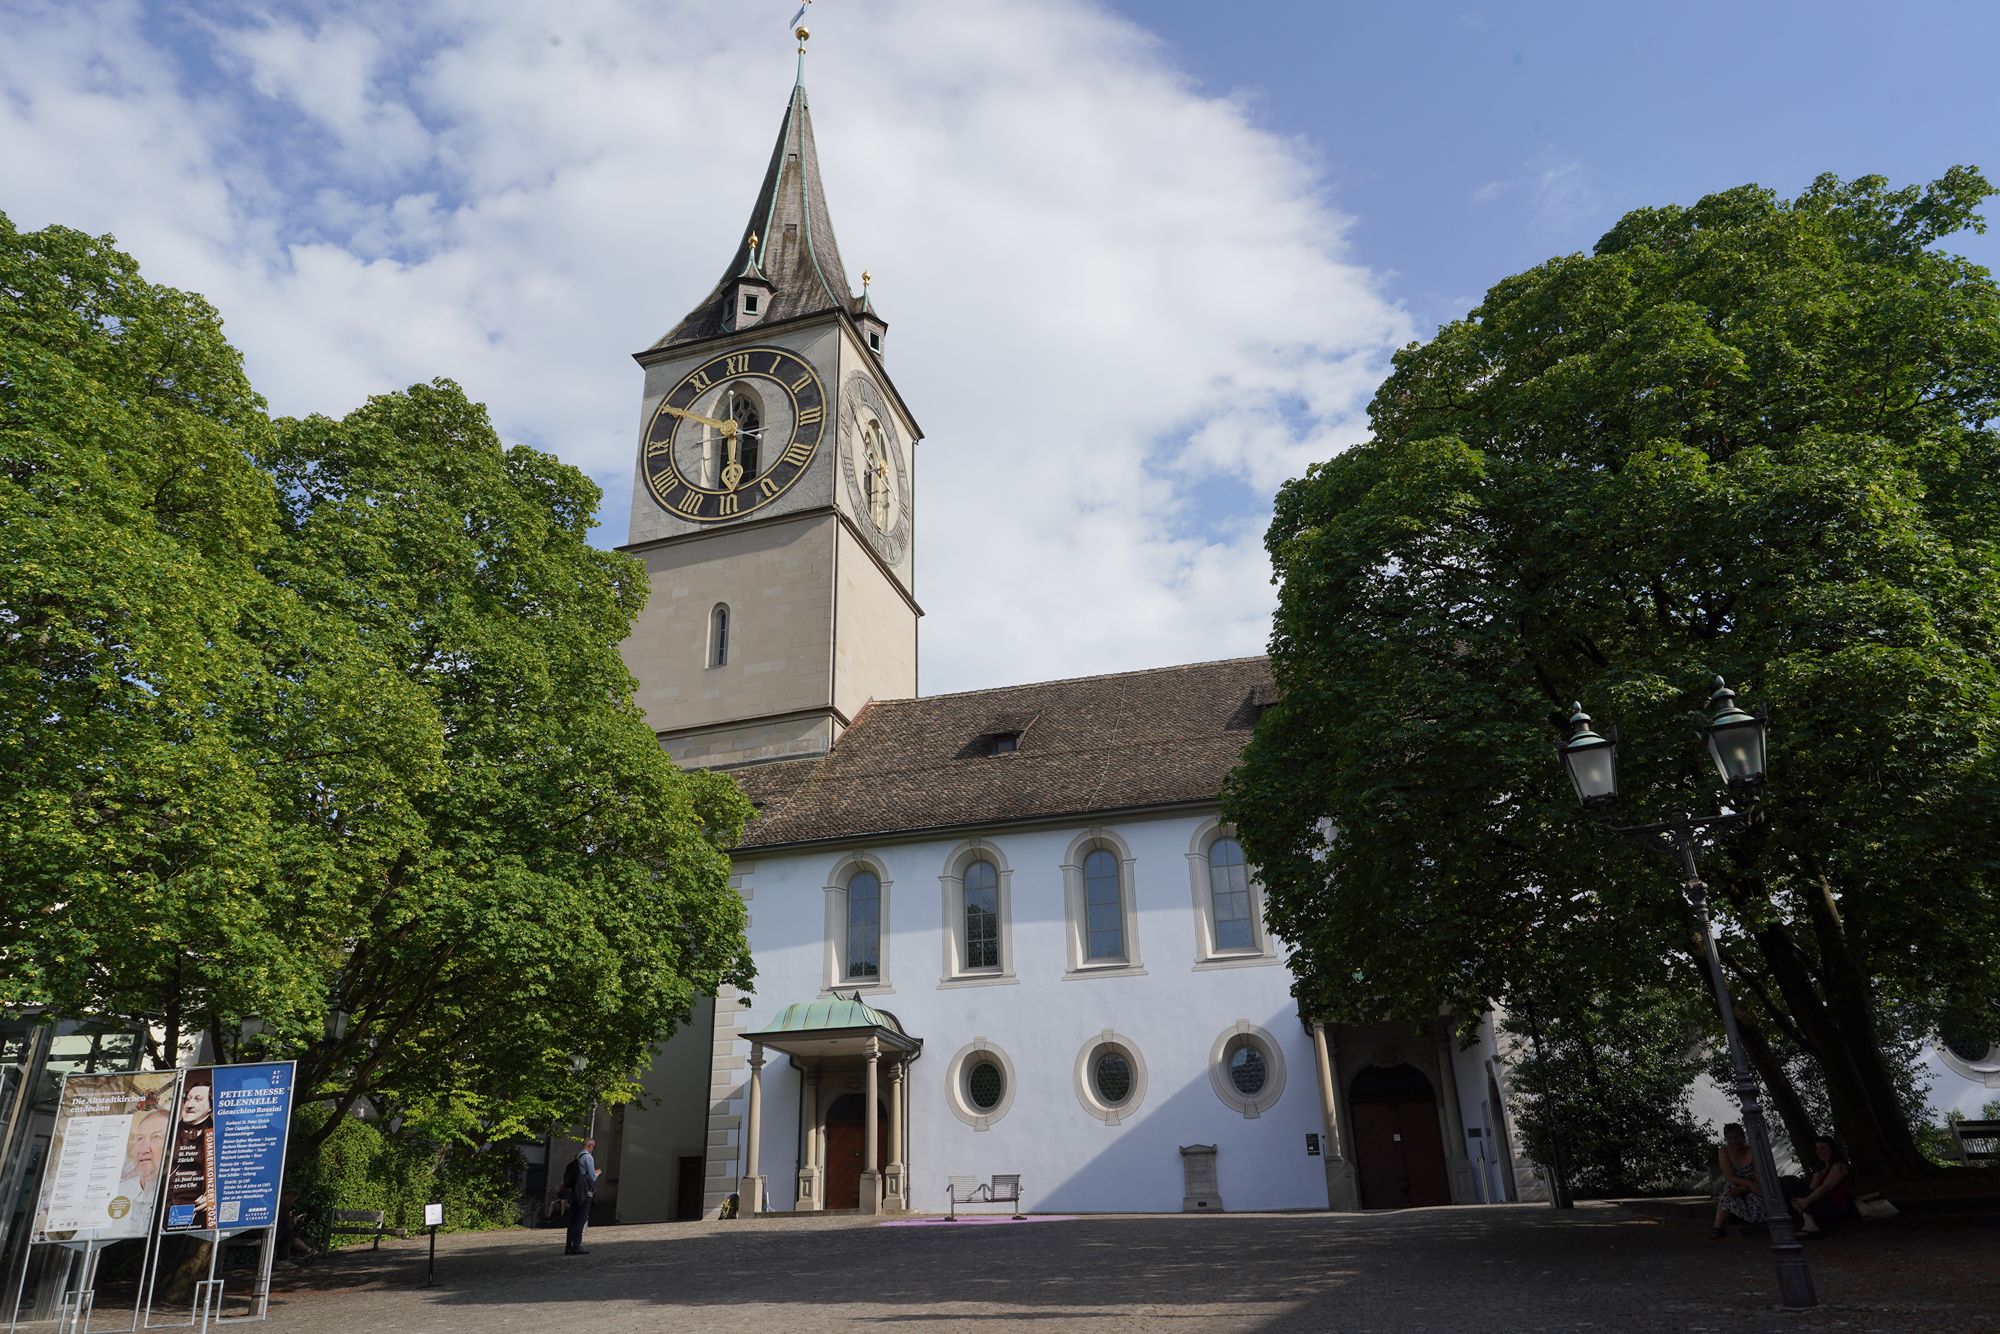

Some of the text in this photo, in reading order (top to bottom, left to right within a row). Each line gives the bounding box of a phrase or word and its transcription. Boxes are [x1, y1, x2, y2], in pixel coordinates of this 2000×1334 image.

[726, 354, 749, 376] XII
[688, 371, 712, 392] XI
[790, 373, 812, 394] II
[800, 405, 822, 426] III
[86, 1095, 146, 1104] Altstadtkirchen
[220, 1088, 285, 1099] PETITE MESSE
[70, 1104, 110, 1112] entdecken
[218, 1097, 278, 1107] SOLENNELLE
[217, 1108, 256, 1116] Gioacchino
[256, 1105, 282, 1113] Rossini
[206, 1132, 216, 1227] SOMMERKONZERT 2026
